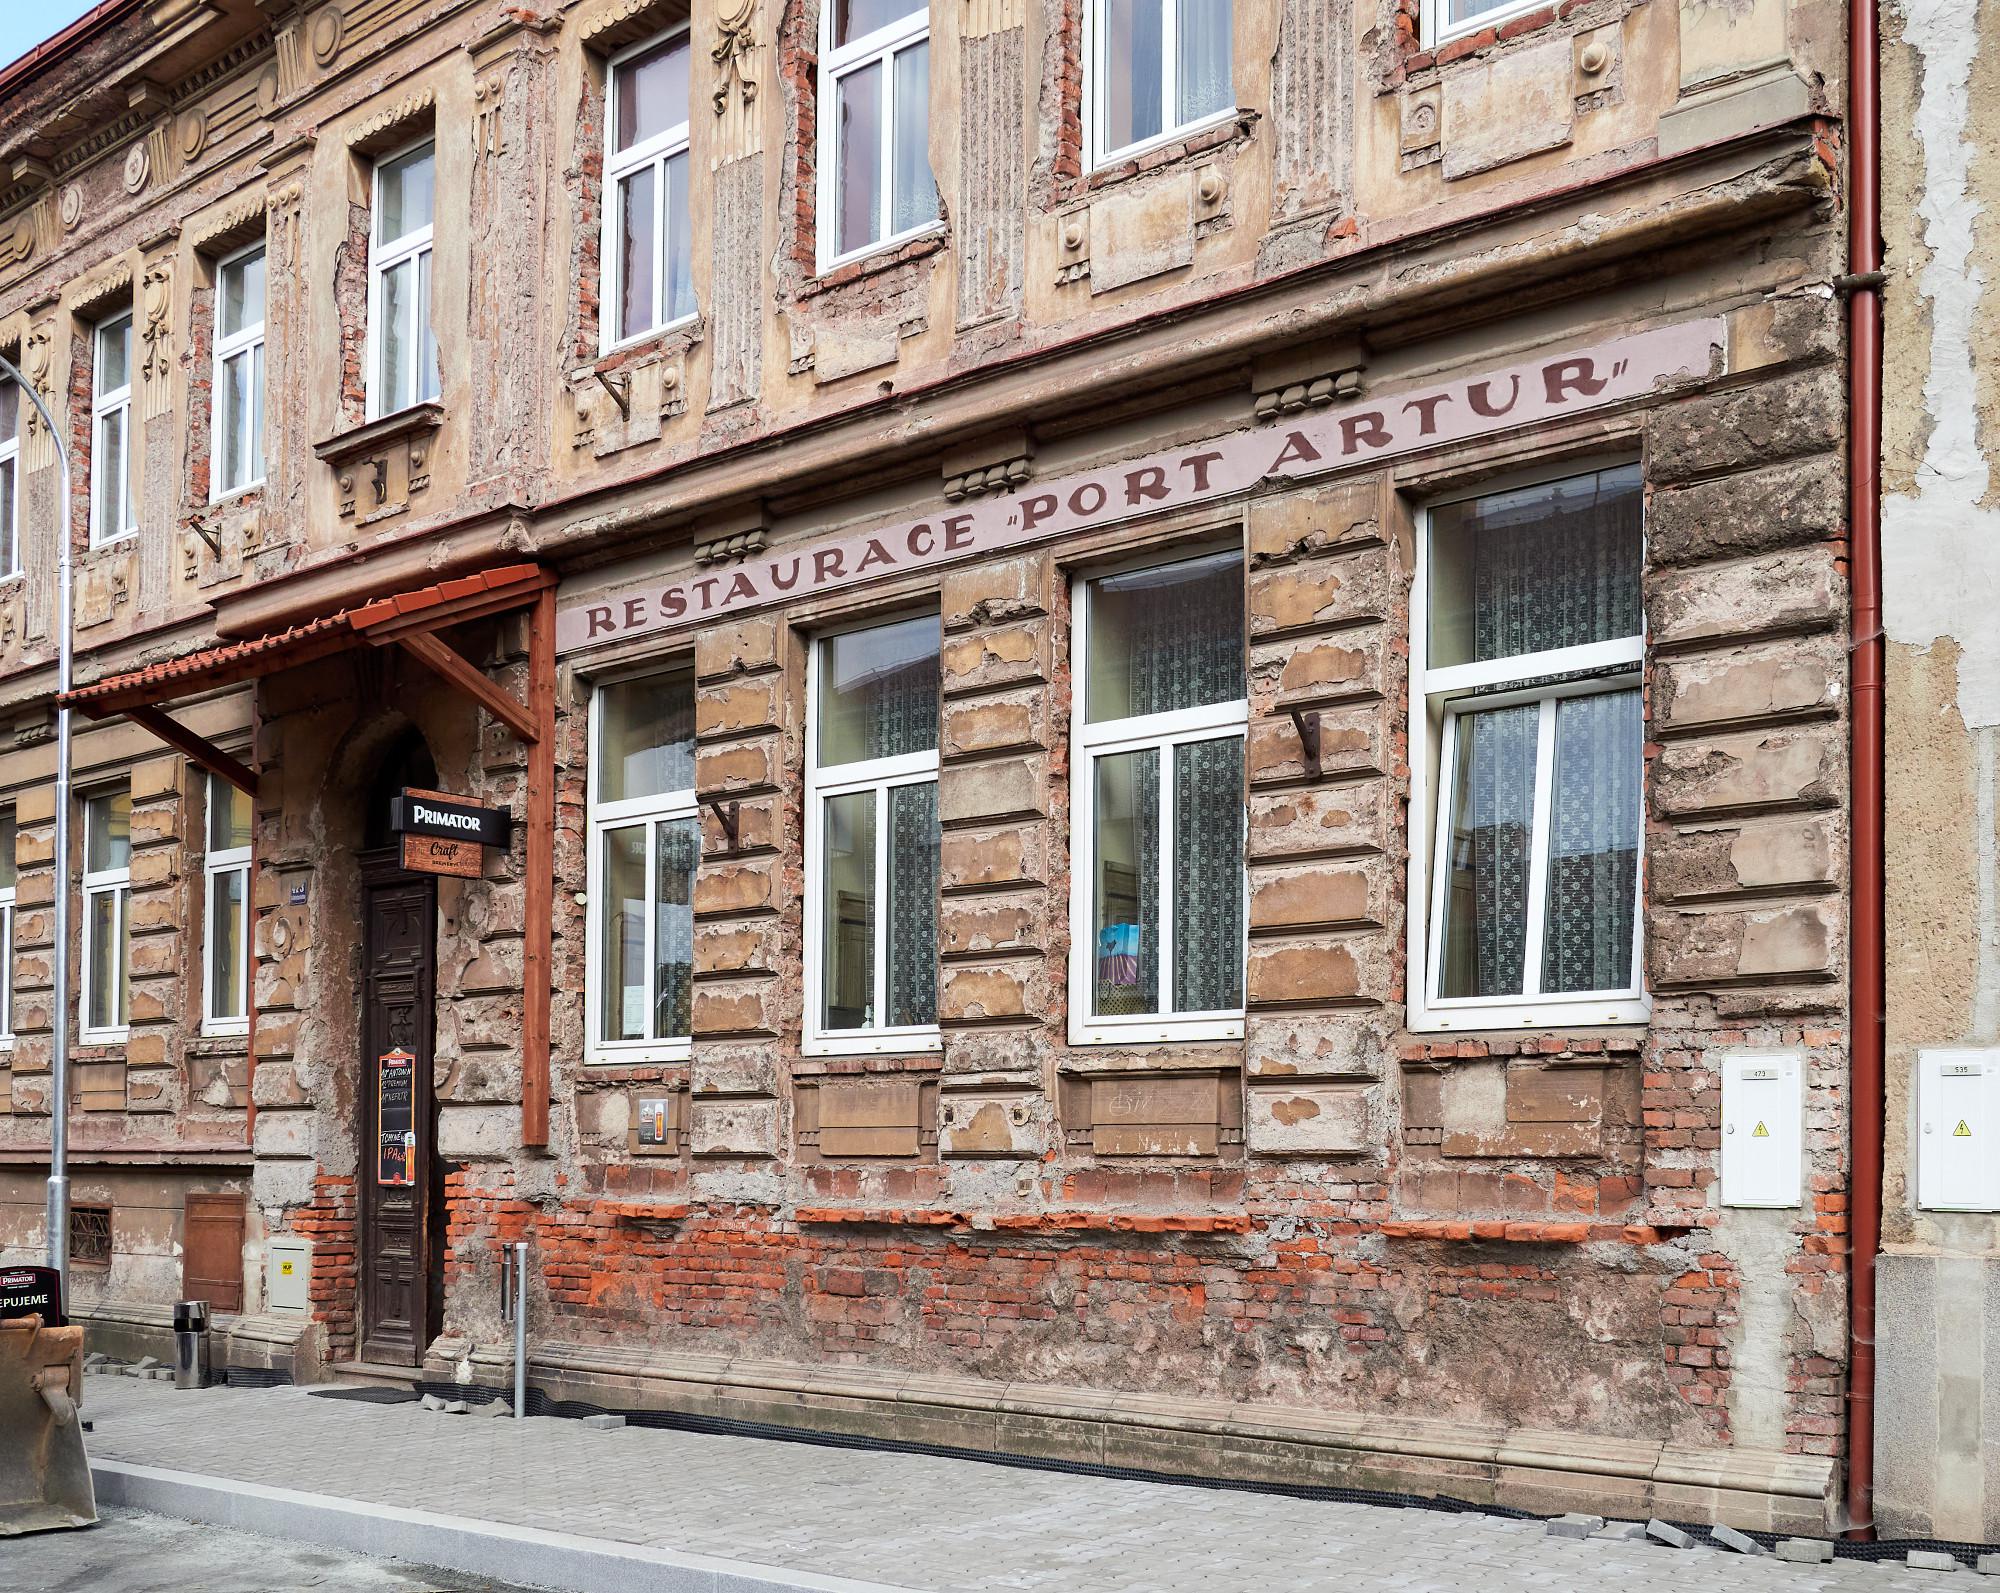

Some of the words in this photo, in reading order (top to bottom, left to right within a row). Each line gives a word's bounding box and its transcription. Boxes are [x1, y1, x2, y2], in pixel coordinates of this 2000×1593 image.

[586, 513, 975, 640] RESTAURACE
[413, 805, 482, 831] PRIMATOR
[430, 841, 459, 860] Craft
